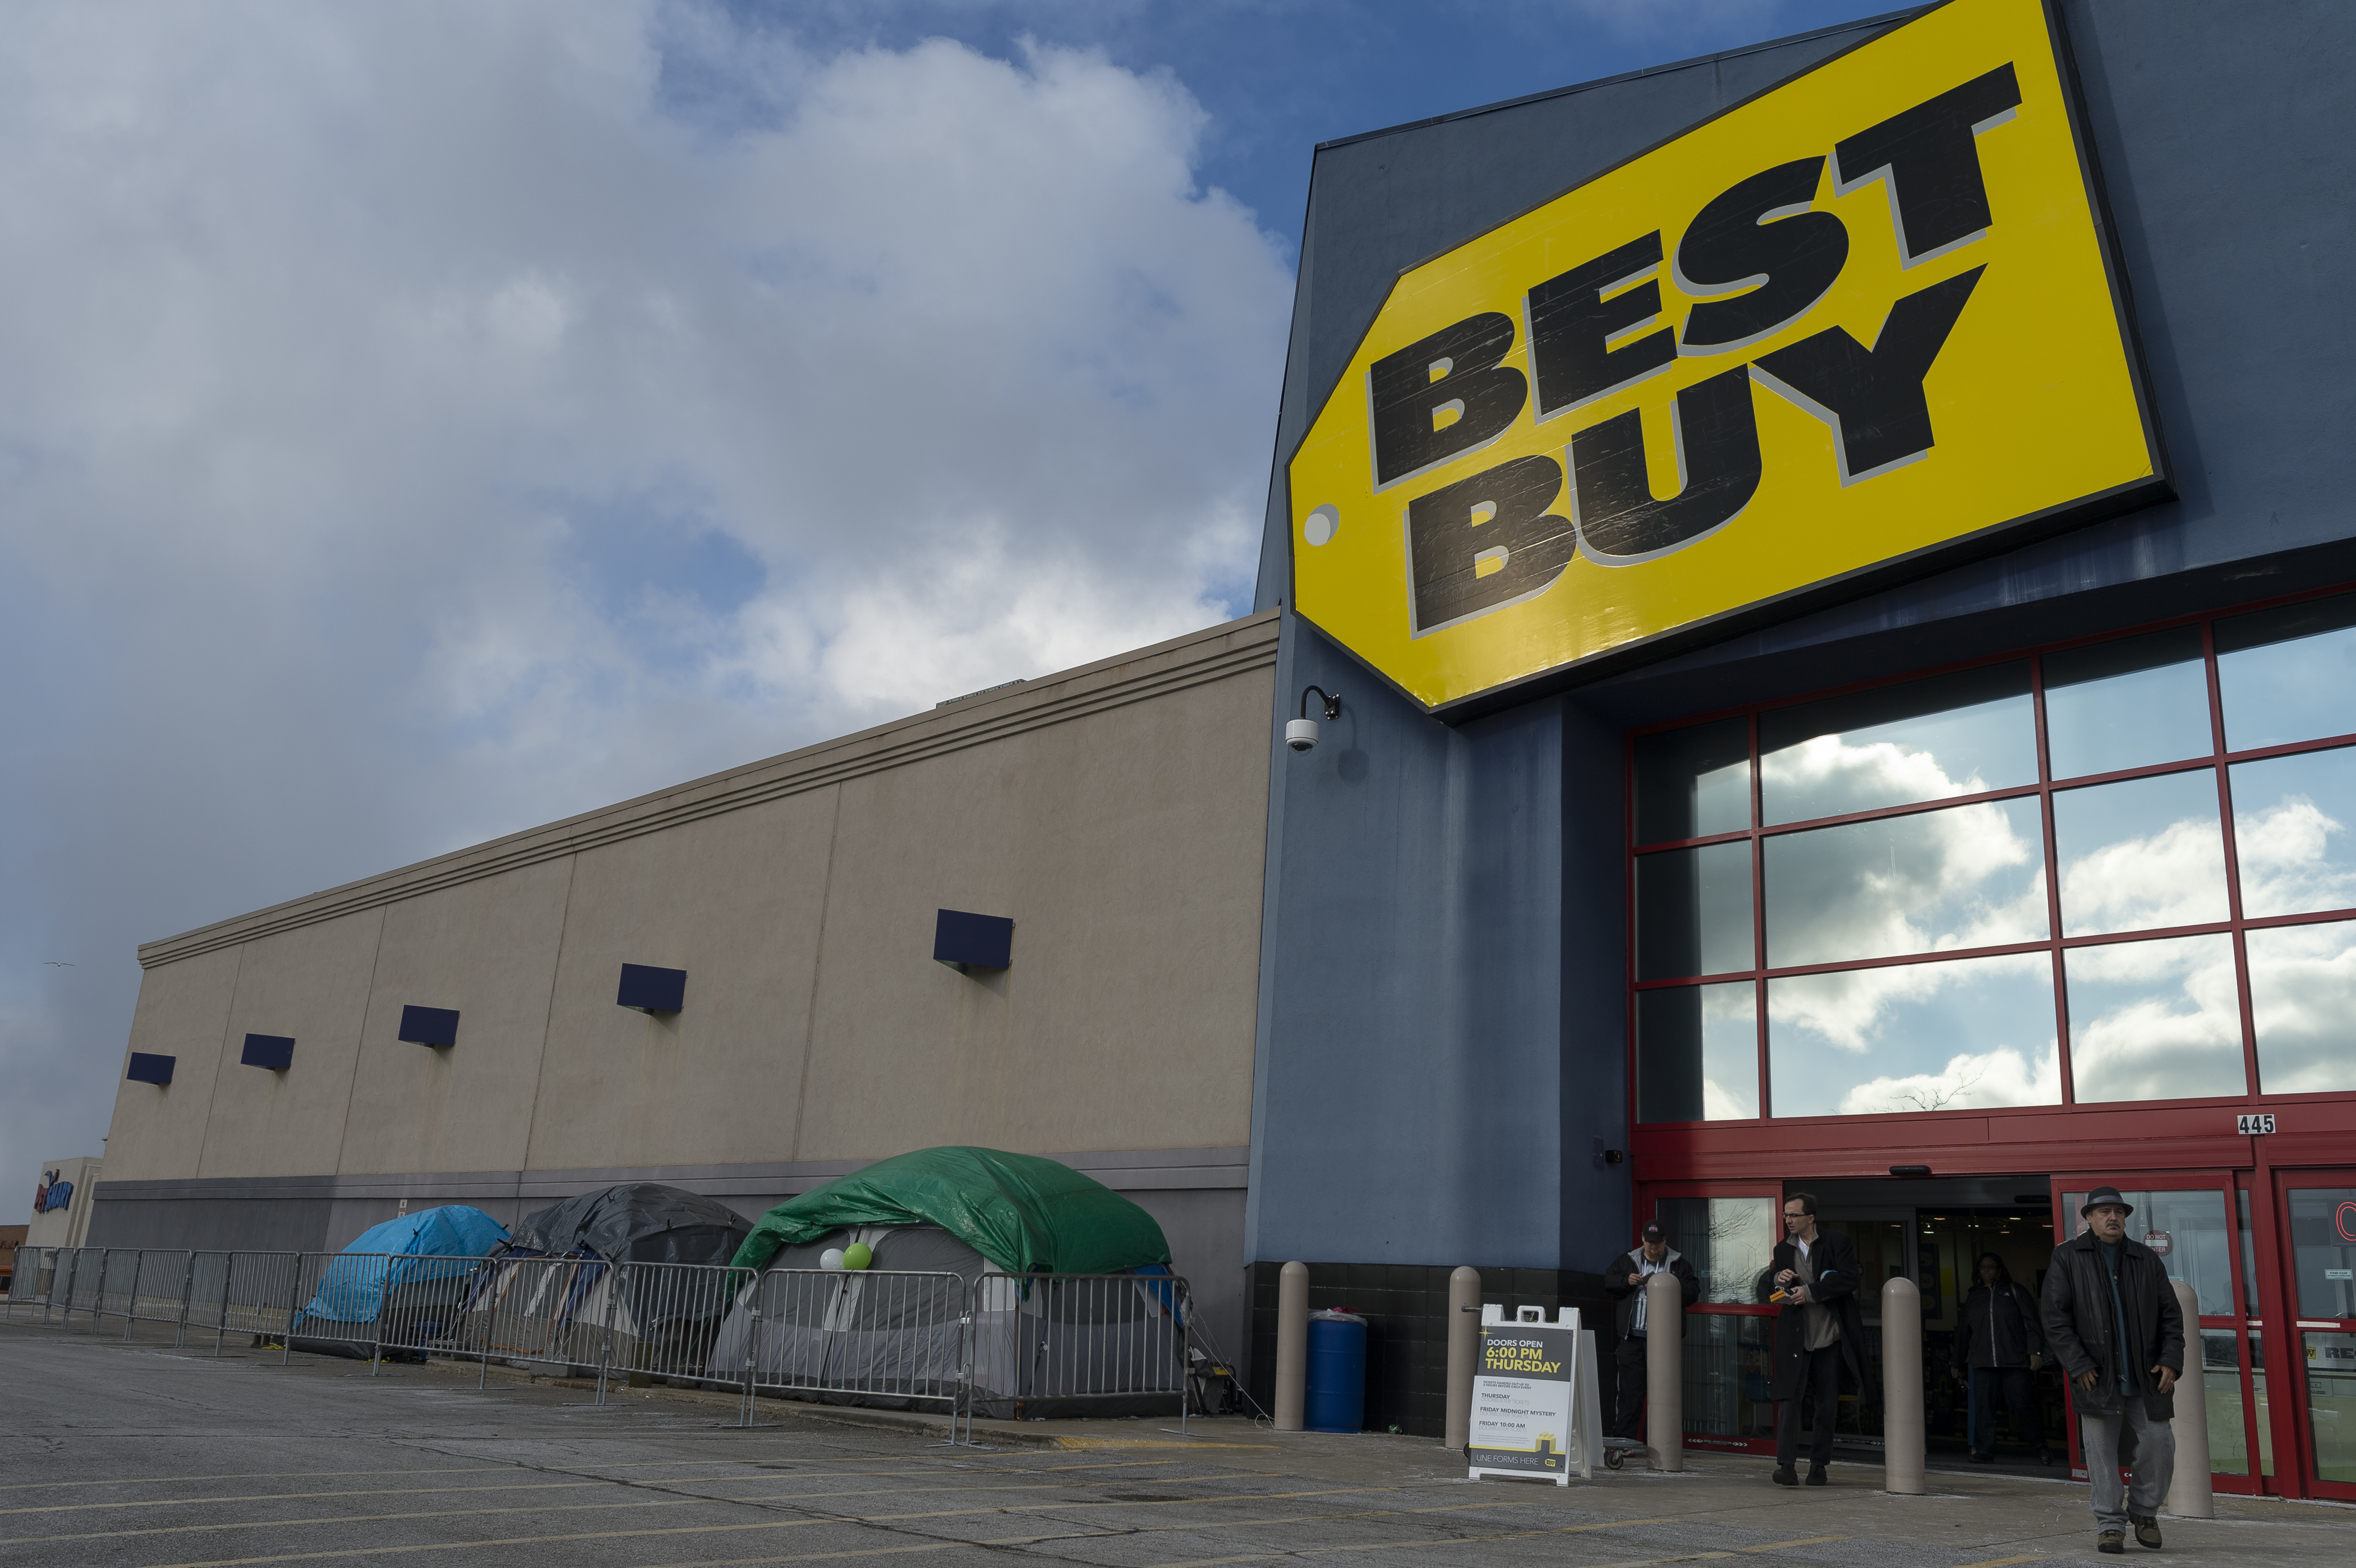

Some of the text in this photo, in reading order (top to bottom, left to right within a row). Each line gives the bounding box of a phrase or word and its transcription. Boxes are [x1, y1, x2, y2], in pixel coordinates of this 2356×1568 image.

[1366, 61, 2022, 493] BEST
[1404, 262, 1989, 638] BUY
[2239, 1115, 2274, 1133] 445
[34, 1181, 74, 1214] PETSMART
[1487, 1347, 1542, 1360] 6:00 PM
[2325, 1347, 2356, 1359] RE
[1485, 1358, 1561, 1373] THURSDAY
[1493, 1455, 1518, 1464] FORMS
